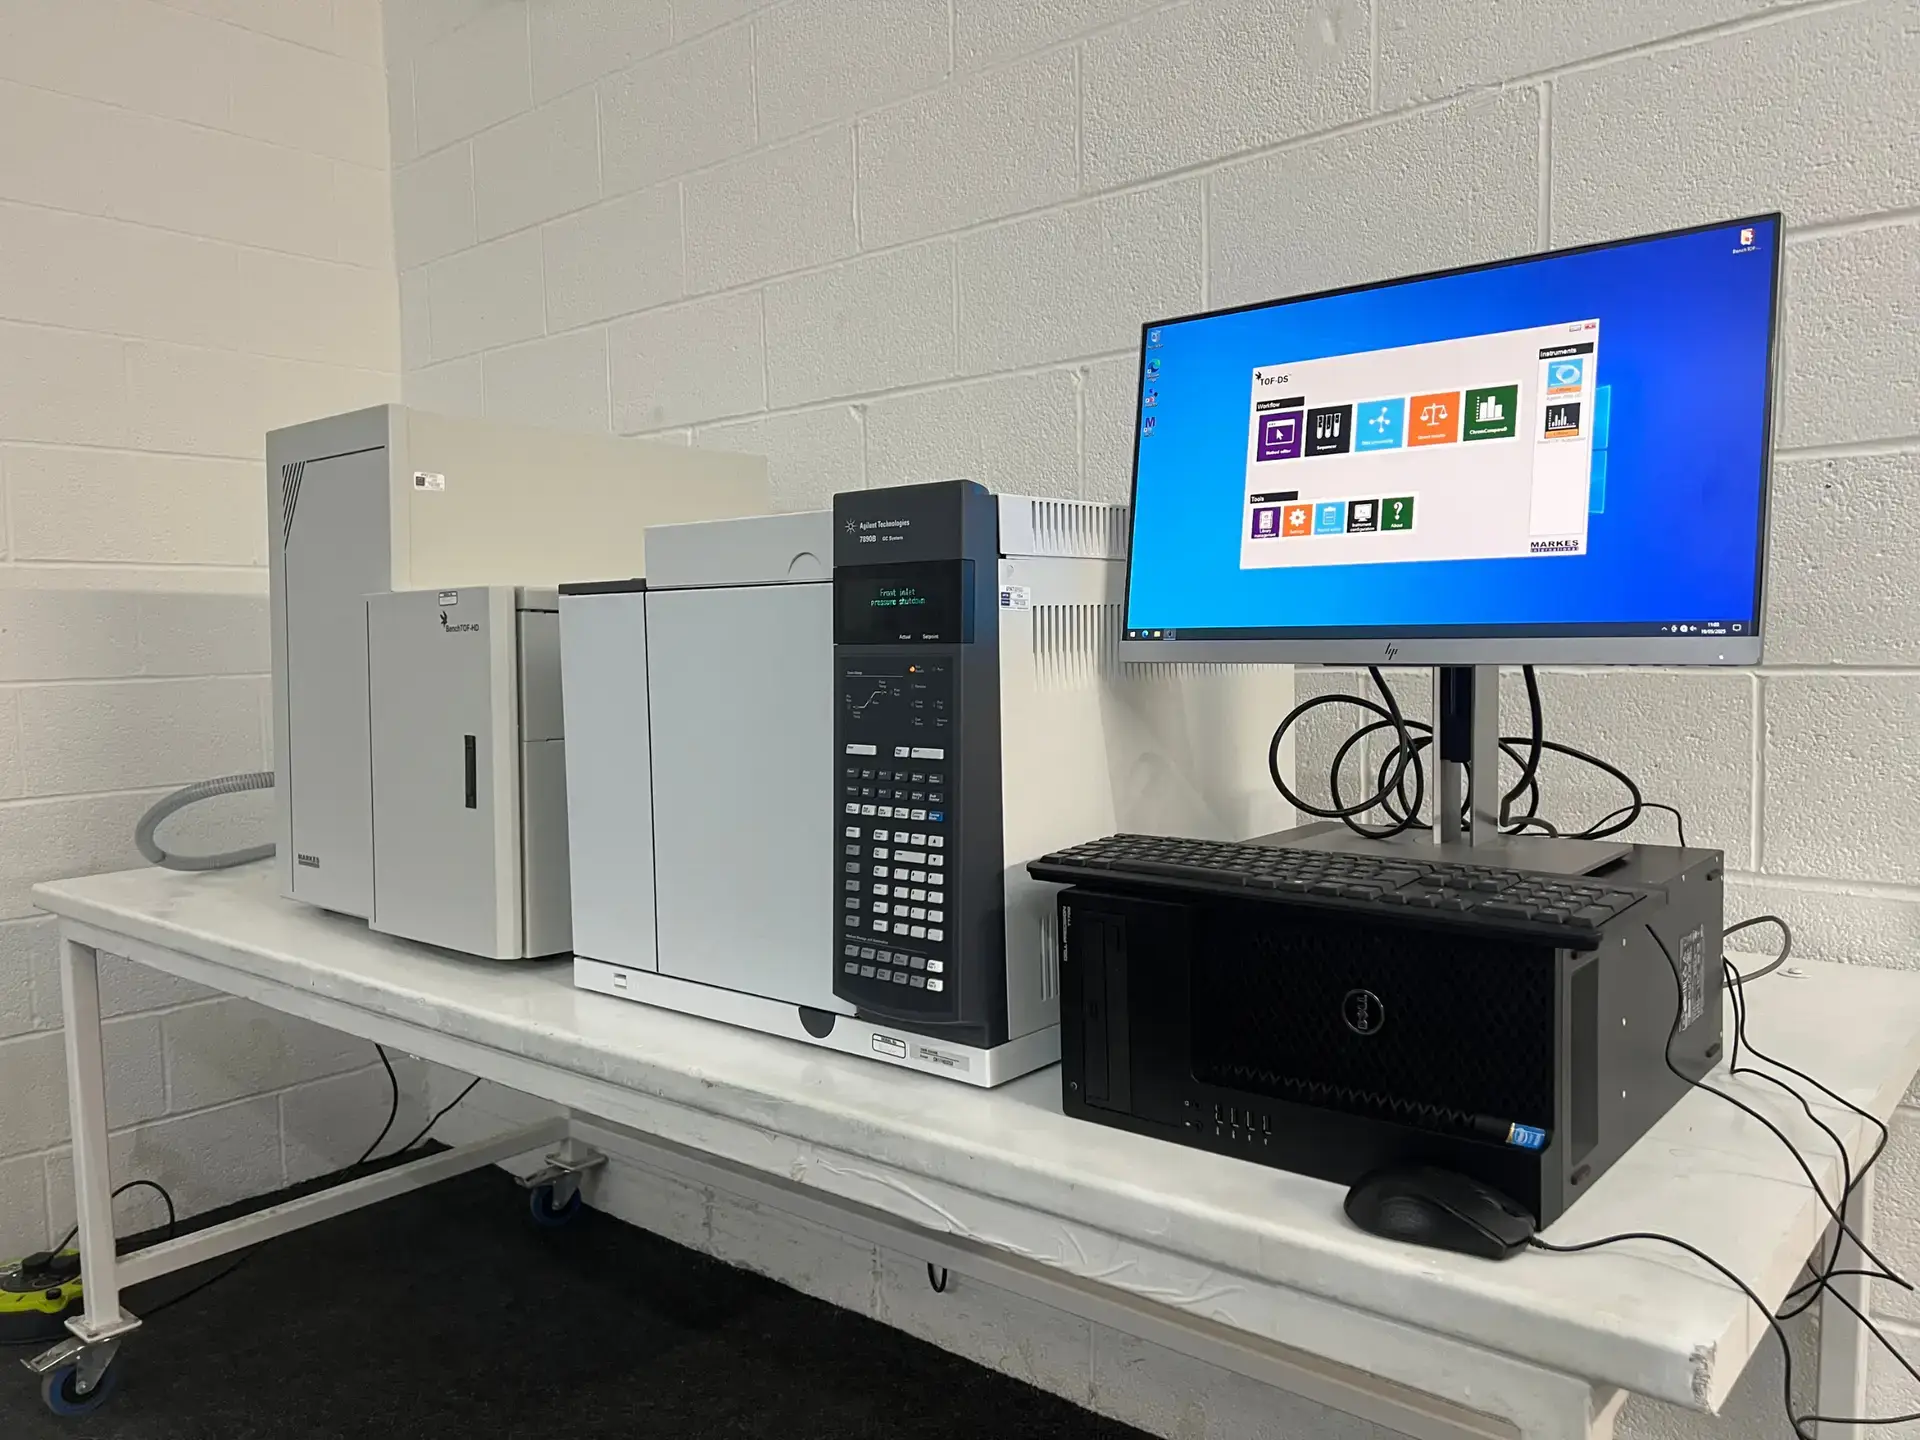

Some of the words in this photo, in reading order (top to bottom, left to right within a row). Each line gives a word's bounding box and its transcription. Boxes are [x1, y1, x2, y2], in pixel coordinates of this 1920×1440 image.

[1540, 347, 1577, 358] Instruments
[1260, 375, 1289, 386] TOF-DS
[859, 521, 877, 531] Agilent
[877, 518, 910, 529] Technologies
[859, 535, 877, 543] 7890B
[1530, 540, 1579, 548] MARKES
[880, 588, 896, 597] Front
[899, 587, 916, 597] inlet
[898, 597, 926, 605] shutdown
[445, 623, 480, 633] BenchTOF-HD
[1356, 994, 1369, 1030] DELL
